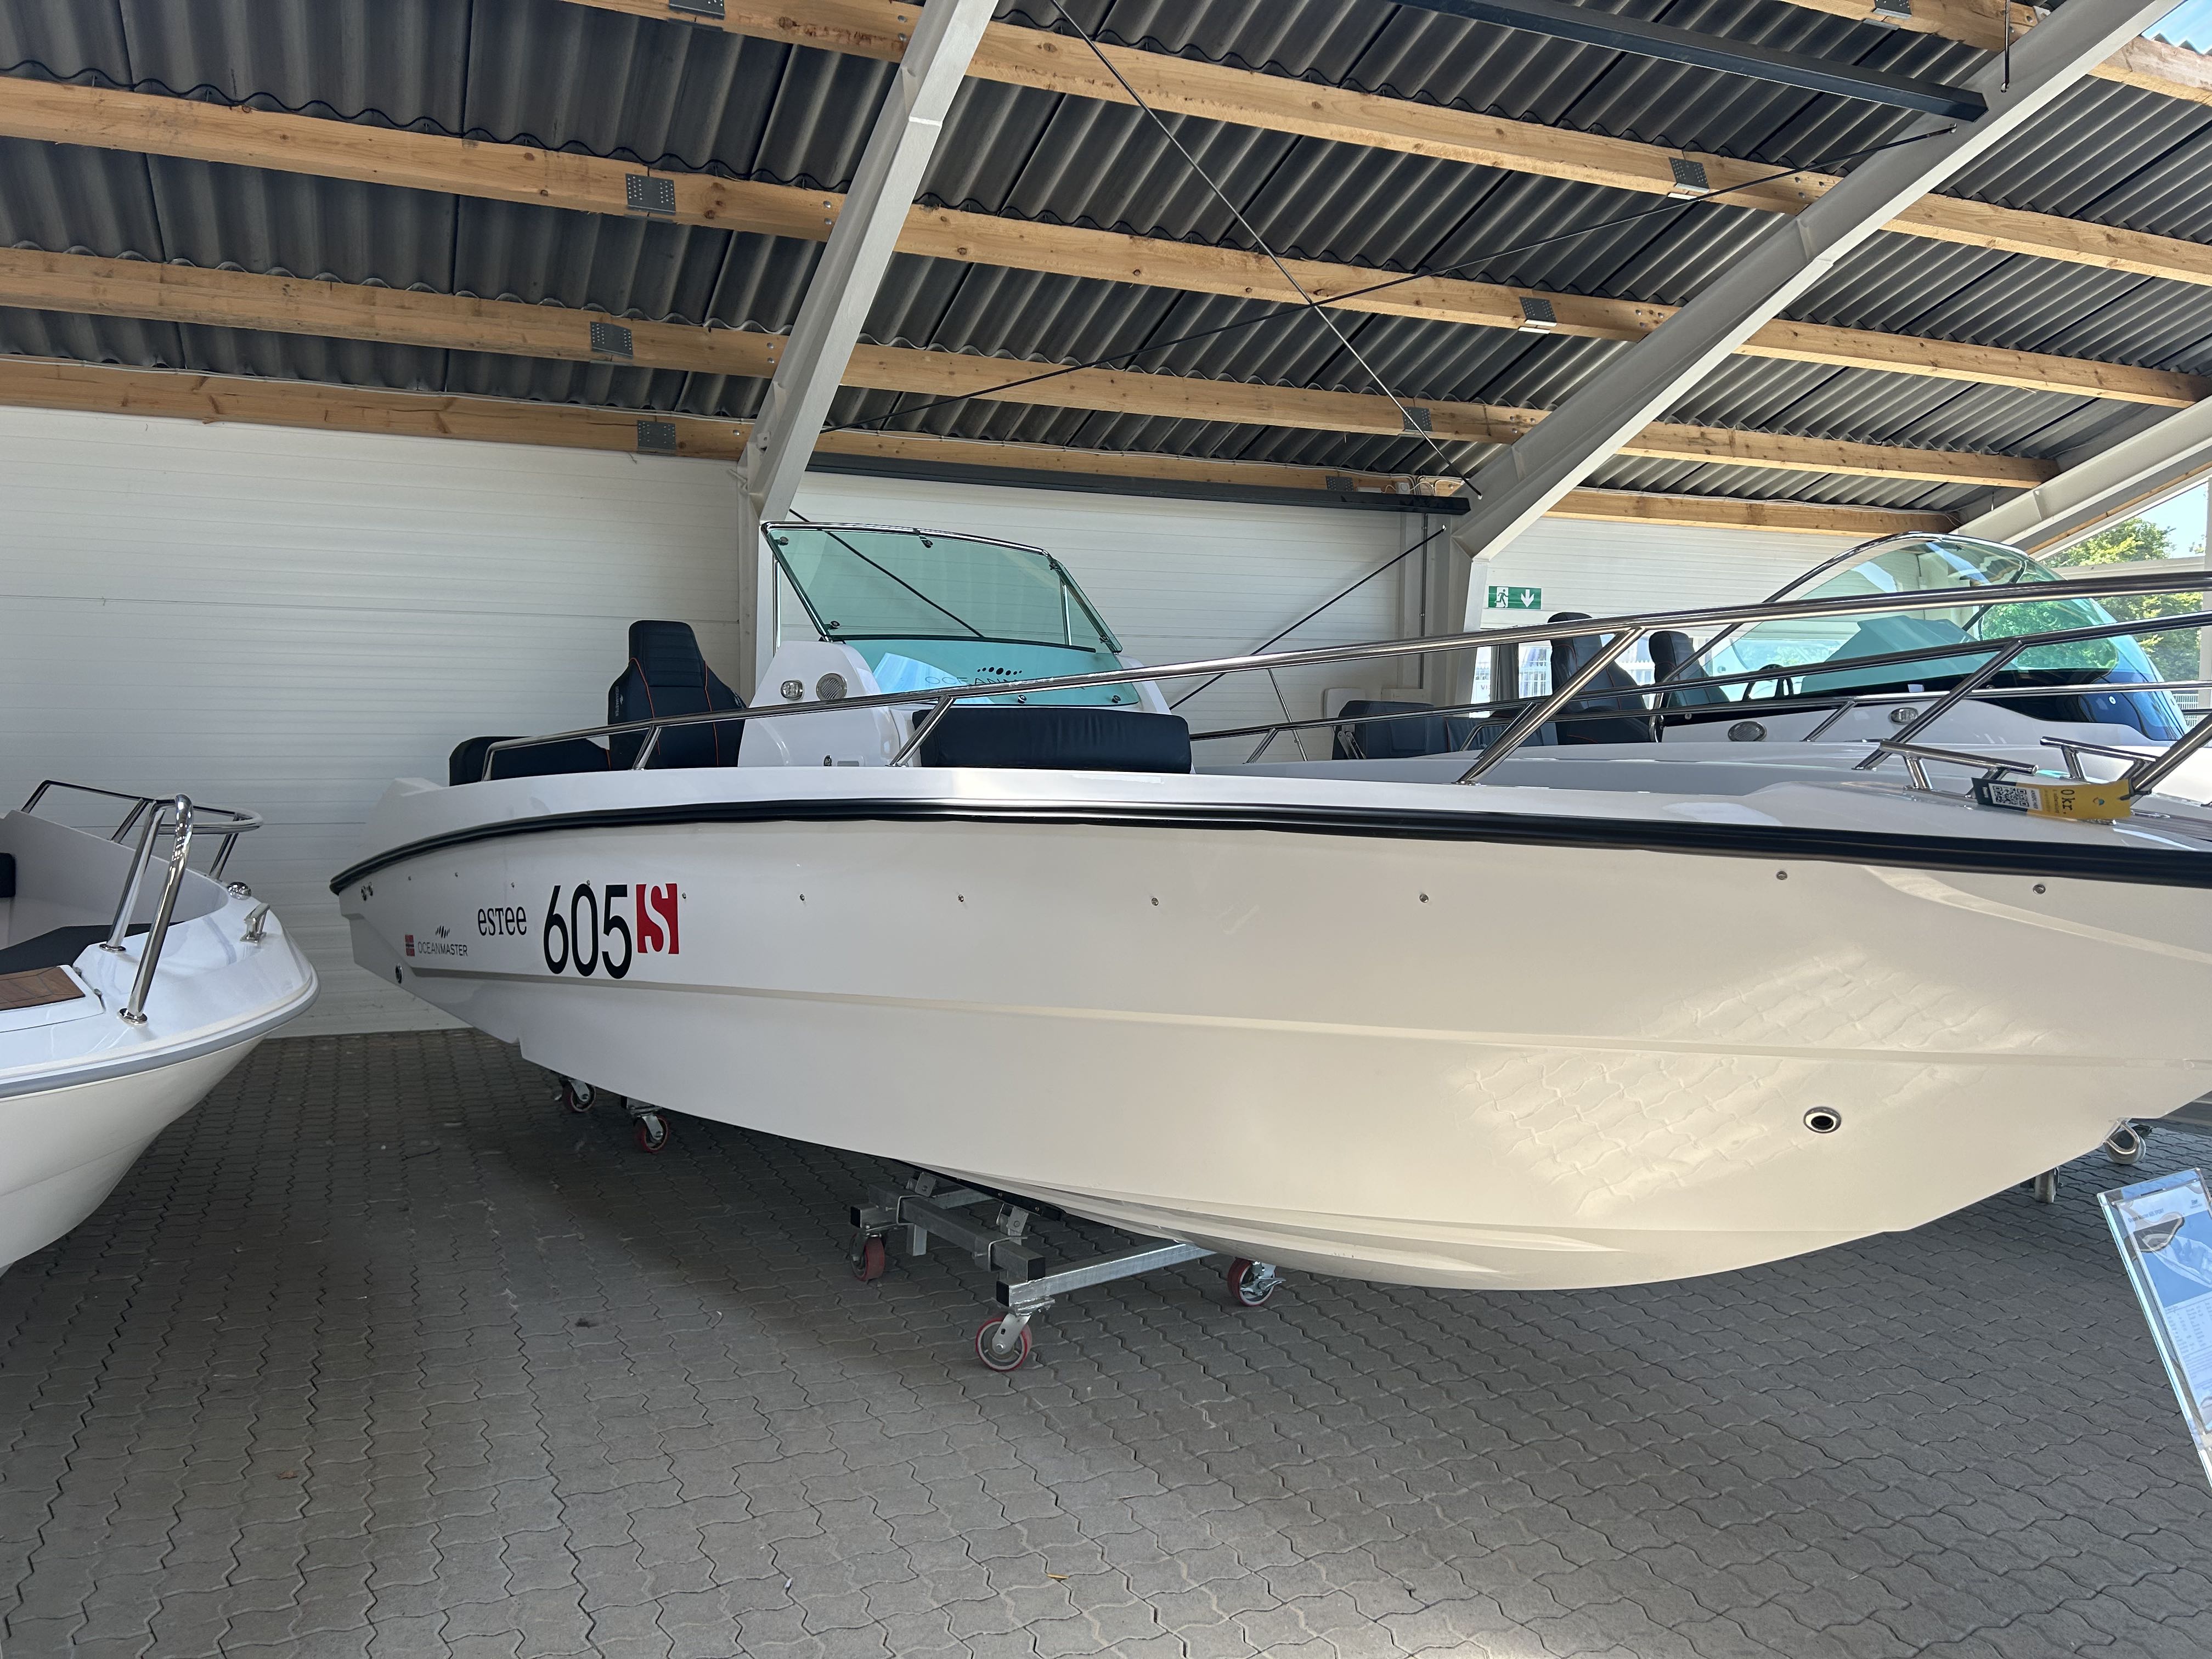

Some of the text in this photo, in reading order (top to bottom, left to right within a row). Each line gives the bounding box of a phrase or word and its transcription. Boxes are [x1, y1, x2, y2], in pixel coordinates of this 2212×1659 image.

[2062, 798, 2075, 814] kr.
[544, 883, 632, 979] 605
[417, 941, 469, 957] OCEANMASTER
